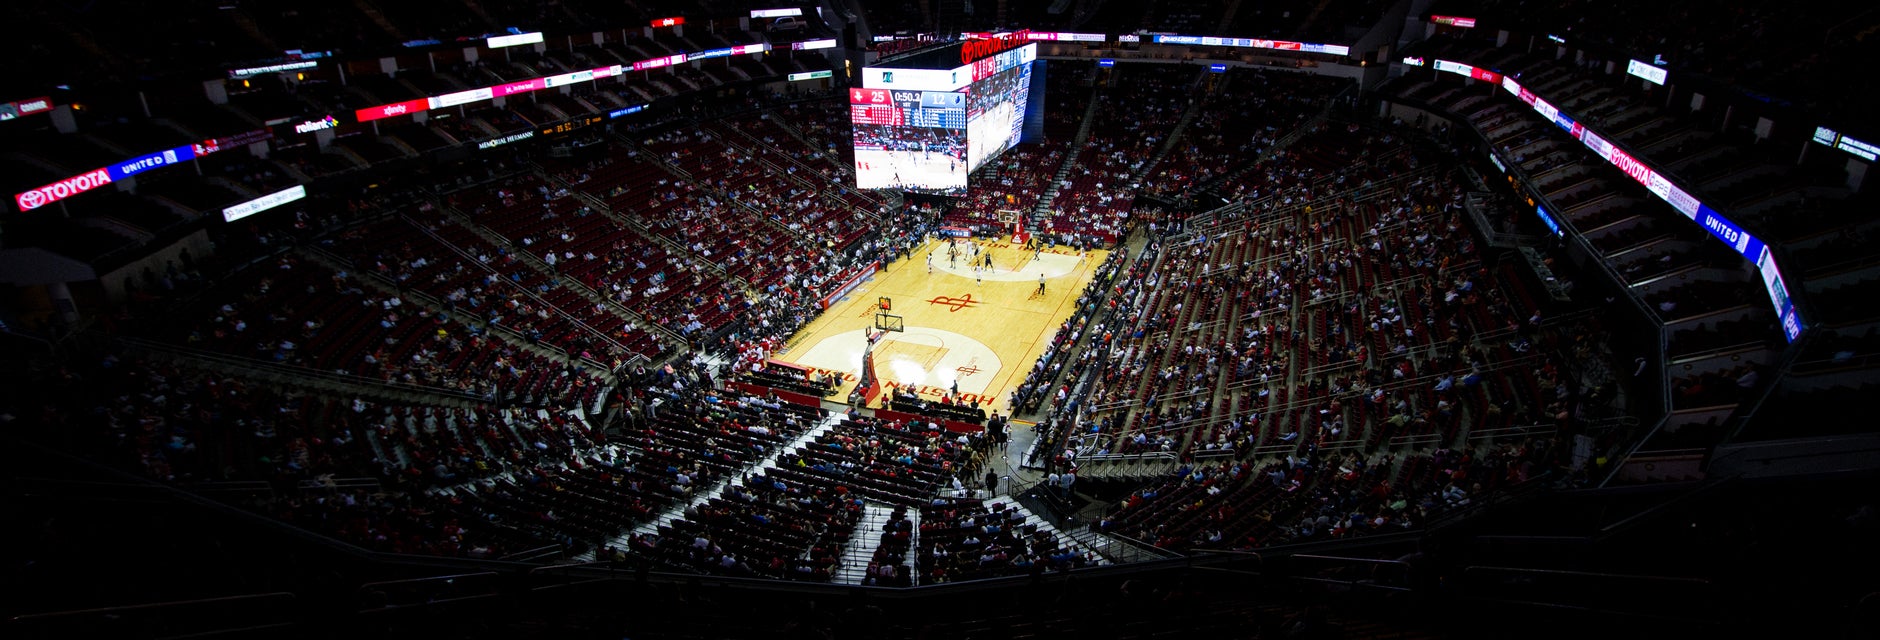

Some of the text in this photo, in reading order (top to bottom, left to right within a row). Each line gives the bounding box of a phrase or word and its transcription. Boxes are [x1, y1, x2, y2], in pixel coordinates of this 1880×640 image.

[974, 28, 1031, 58] TOYOTA CENTER
[871, 91, 885, 103] 25
[931, 93, 946, 105] 12
[295, 118, 329, 133] reliant
[478, 136, 508, 150] MEMORIAL
[121, 156, 163, 174] UNITED
[1618, 153, 1649, 186] TOYOTA
[41, 169, 112, 201] TOYOTA
[1705, 214, 1738, 243] UNITED
